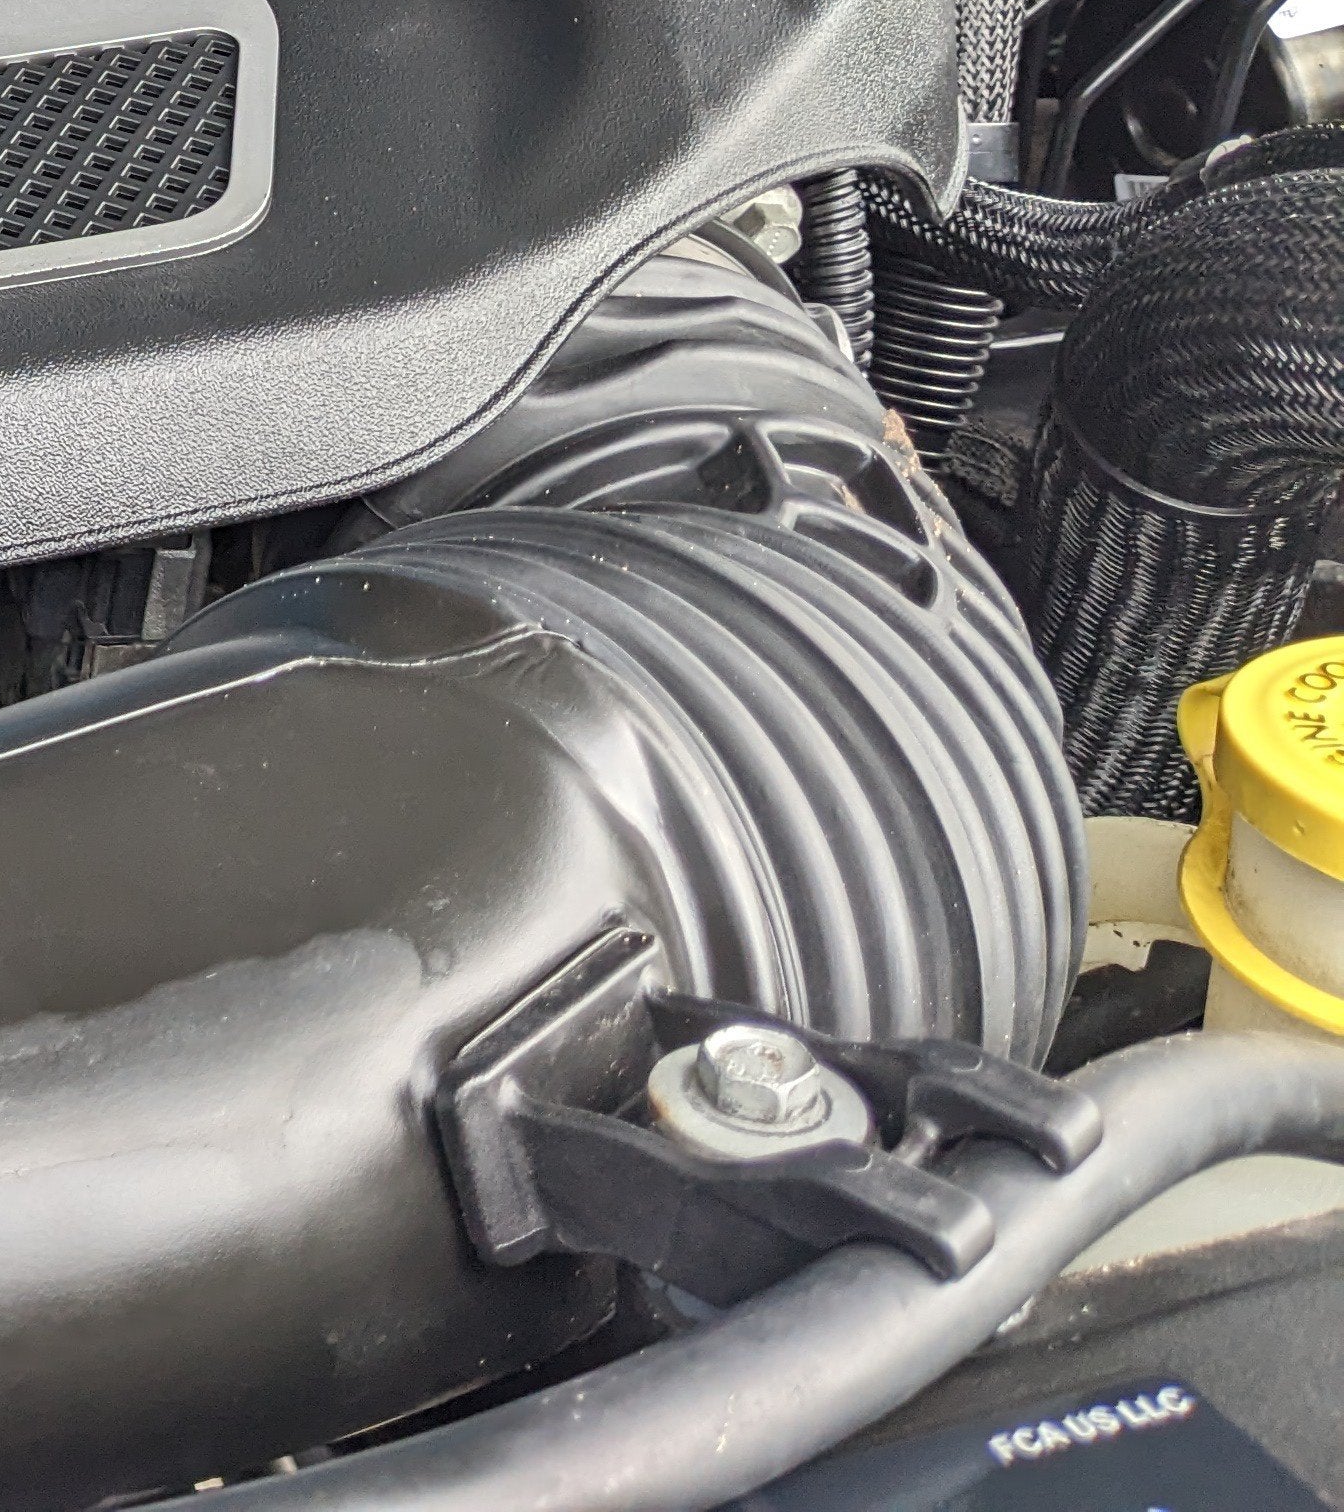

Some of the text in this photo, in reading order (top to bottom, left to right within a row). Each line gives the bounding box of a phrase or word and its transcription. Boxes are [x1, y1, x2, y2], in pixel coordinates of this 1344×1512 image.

[987, 1384, 1196, 1467] FCA US LLC
